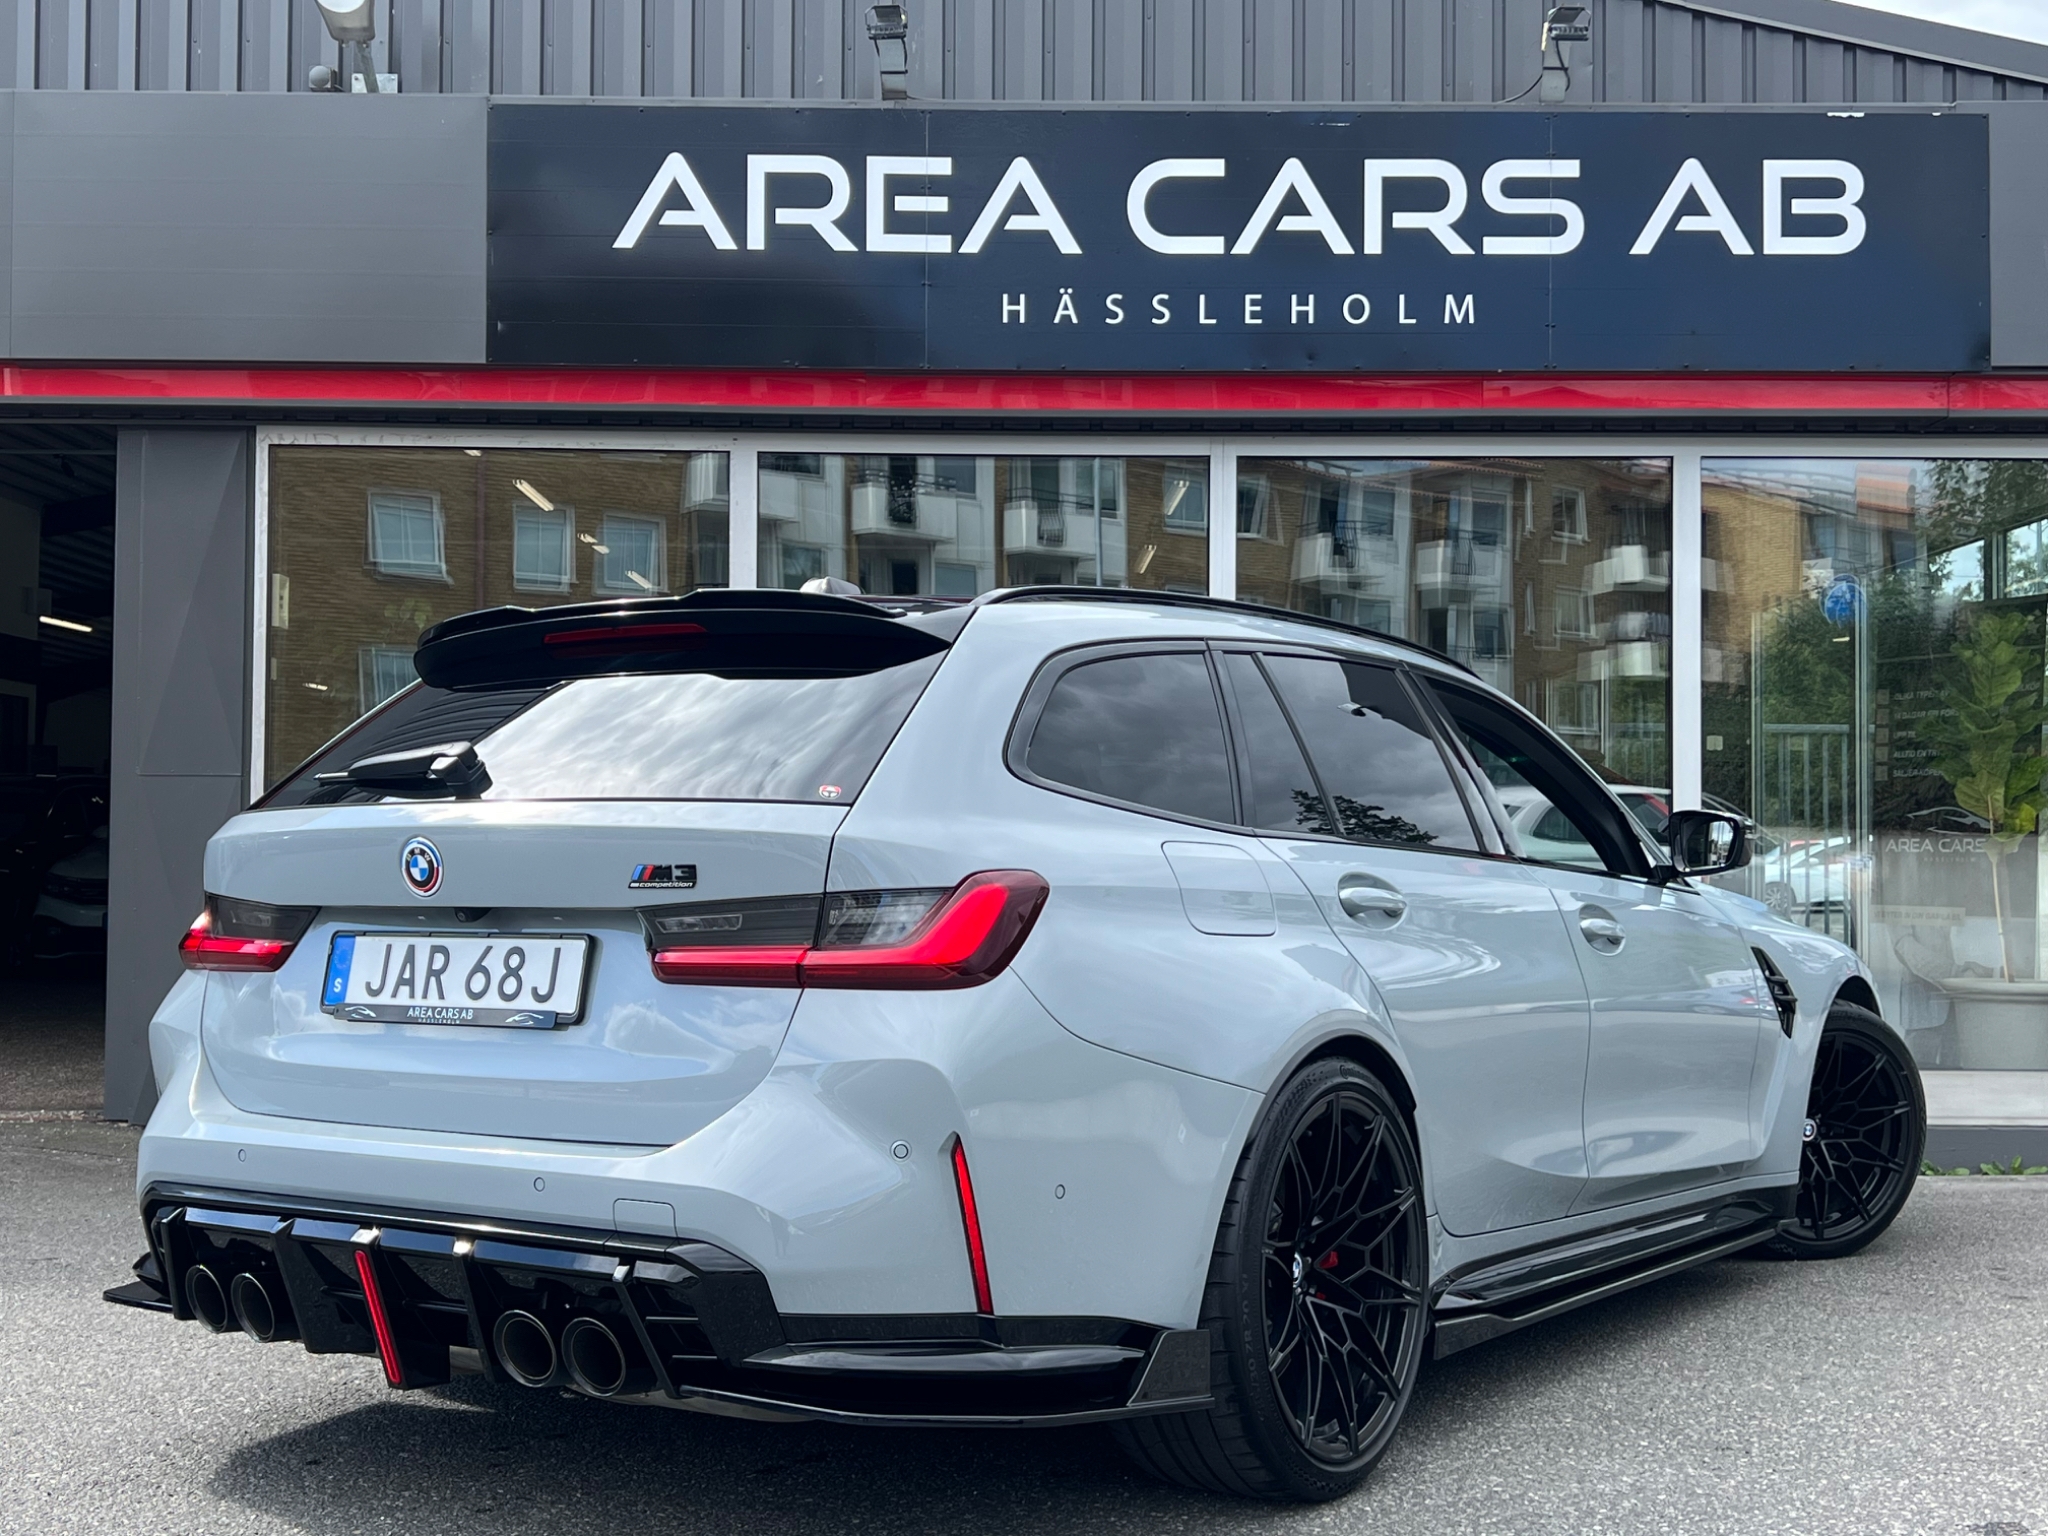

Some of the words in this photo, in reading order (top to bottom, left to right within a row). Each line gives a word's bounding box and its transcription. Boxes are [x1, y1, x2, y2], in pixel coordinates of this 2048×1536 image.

[612, 151, 1083, 254] AREA
[1126, 157, 1586, 255] CARS
[1629, 157, 1867, 255] AB
[1002, 288, 1476, 325] HÄSSLEHOLM
[1885, 838, 1934, 853] AREA
[1938, 838, 1987, 853] CARS
[406, 848, 431, 861] BMW
[648, 863, 697, 880] M3
[639, 881, 693, 889] competition
[333, 978, 342, 992] S
[365, 944, 450, 1000] JAR
[464, 945, 562, 1003] 68J
[406, 1006, 433, 1018] AREA
[434, 1007, 460, 1019] CARS
[460, 1008, 474, 1020] AB
